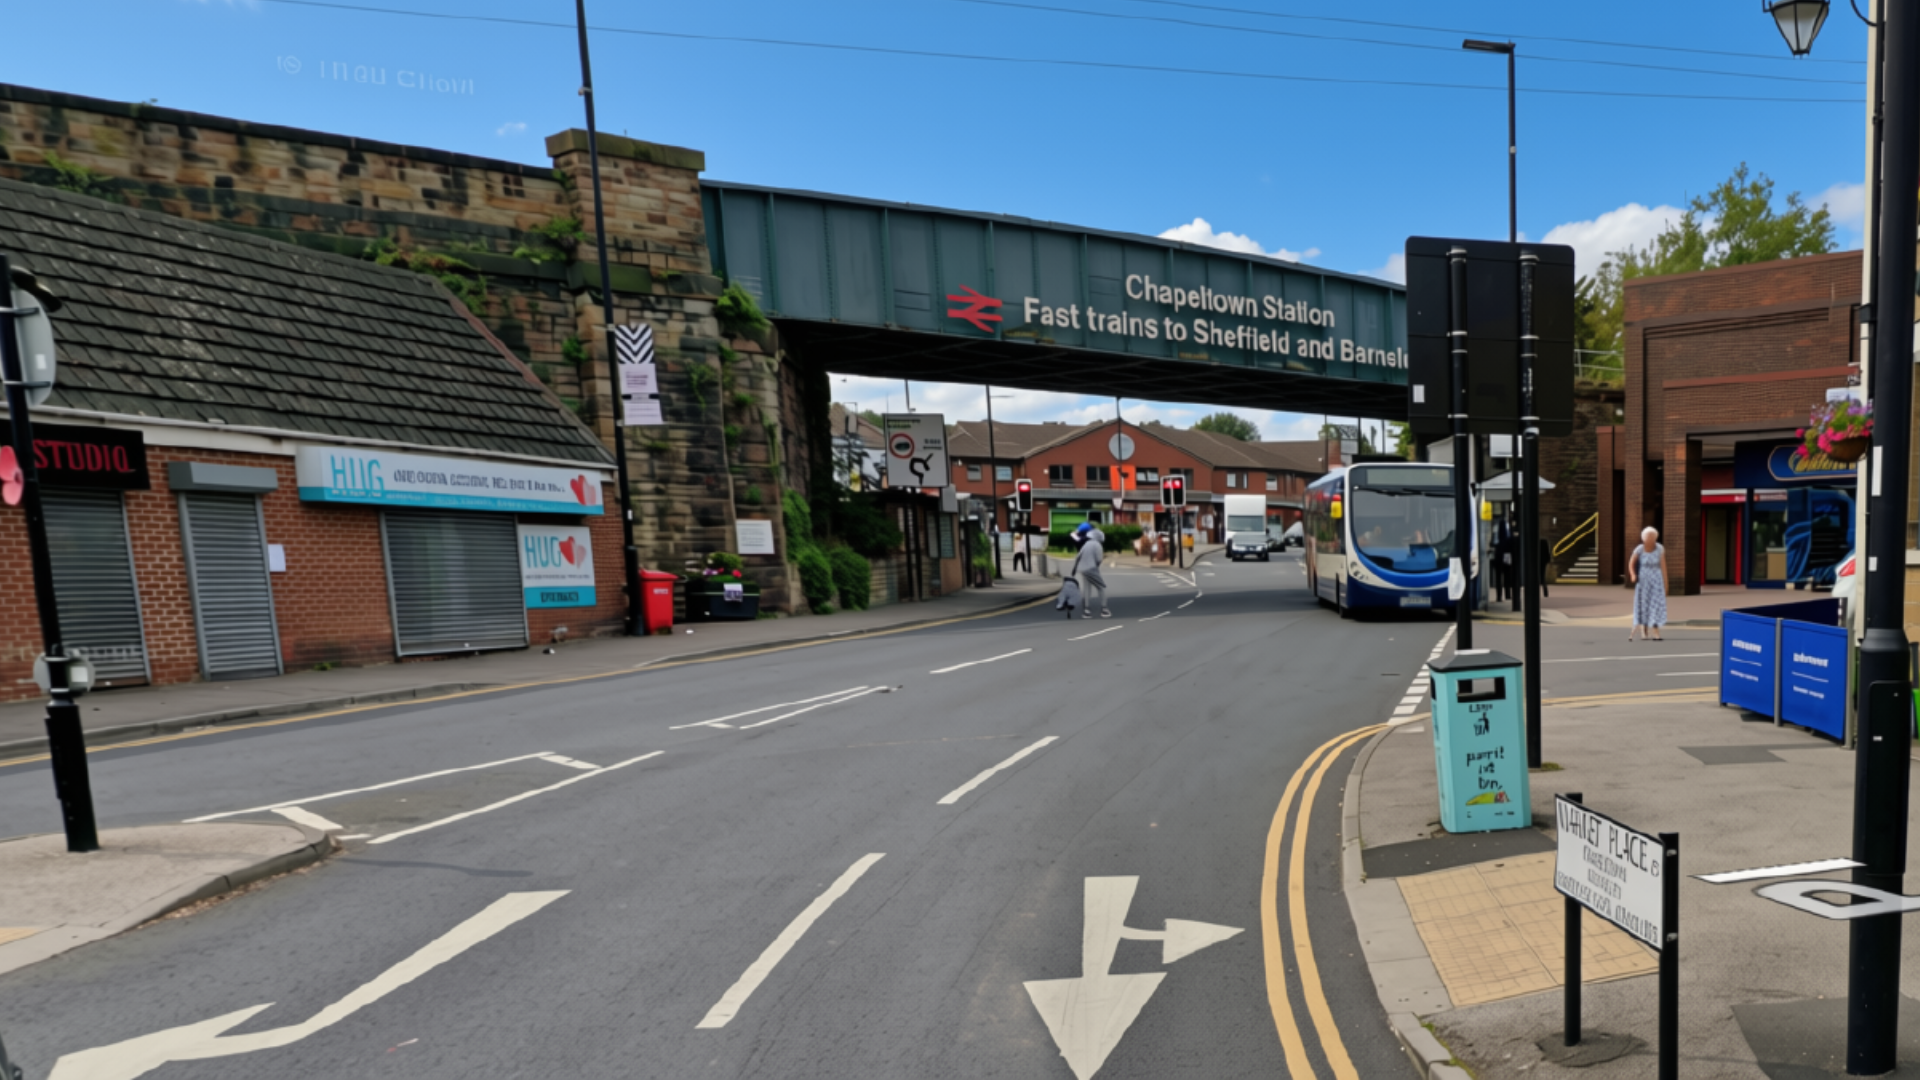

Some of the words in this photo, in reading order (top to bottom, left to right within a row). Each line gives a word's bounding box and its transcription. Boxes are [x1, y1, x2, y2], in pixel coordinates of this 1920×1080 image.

[1125, 273, 1259, 318] Chapeltown
[1262, 294, 1335, 328] Station
[1023, 295, 1081, 330] Fast
[1086, 306, 1159, 339] trains
[1163, 316, 1188, 341] to
[1193, 318, 1290, 355] Sheffield
[1296, 336, 1335, 361] and
[330, 454, 385, 491] HUG
[524, 534, 562, 569] HUG
[1608, 823, 1648, 873] PLACE
